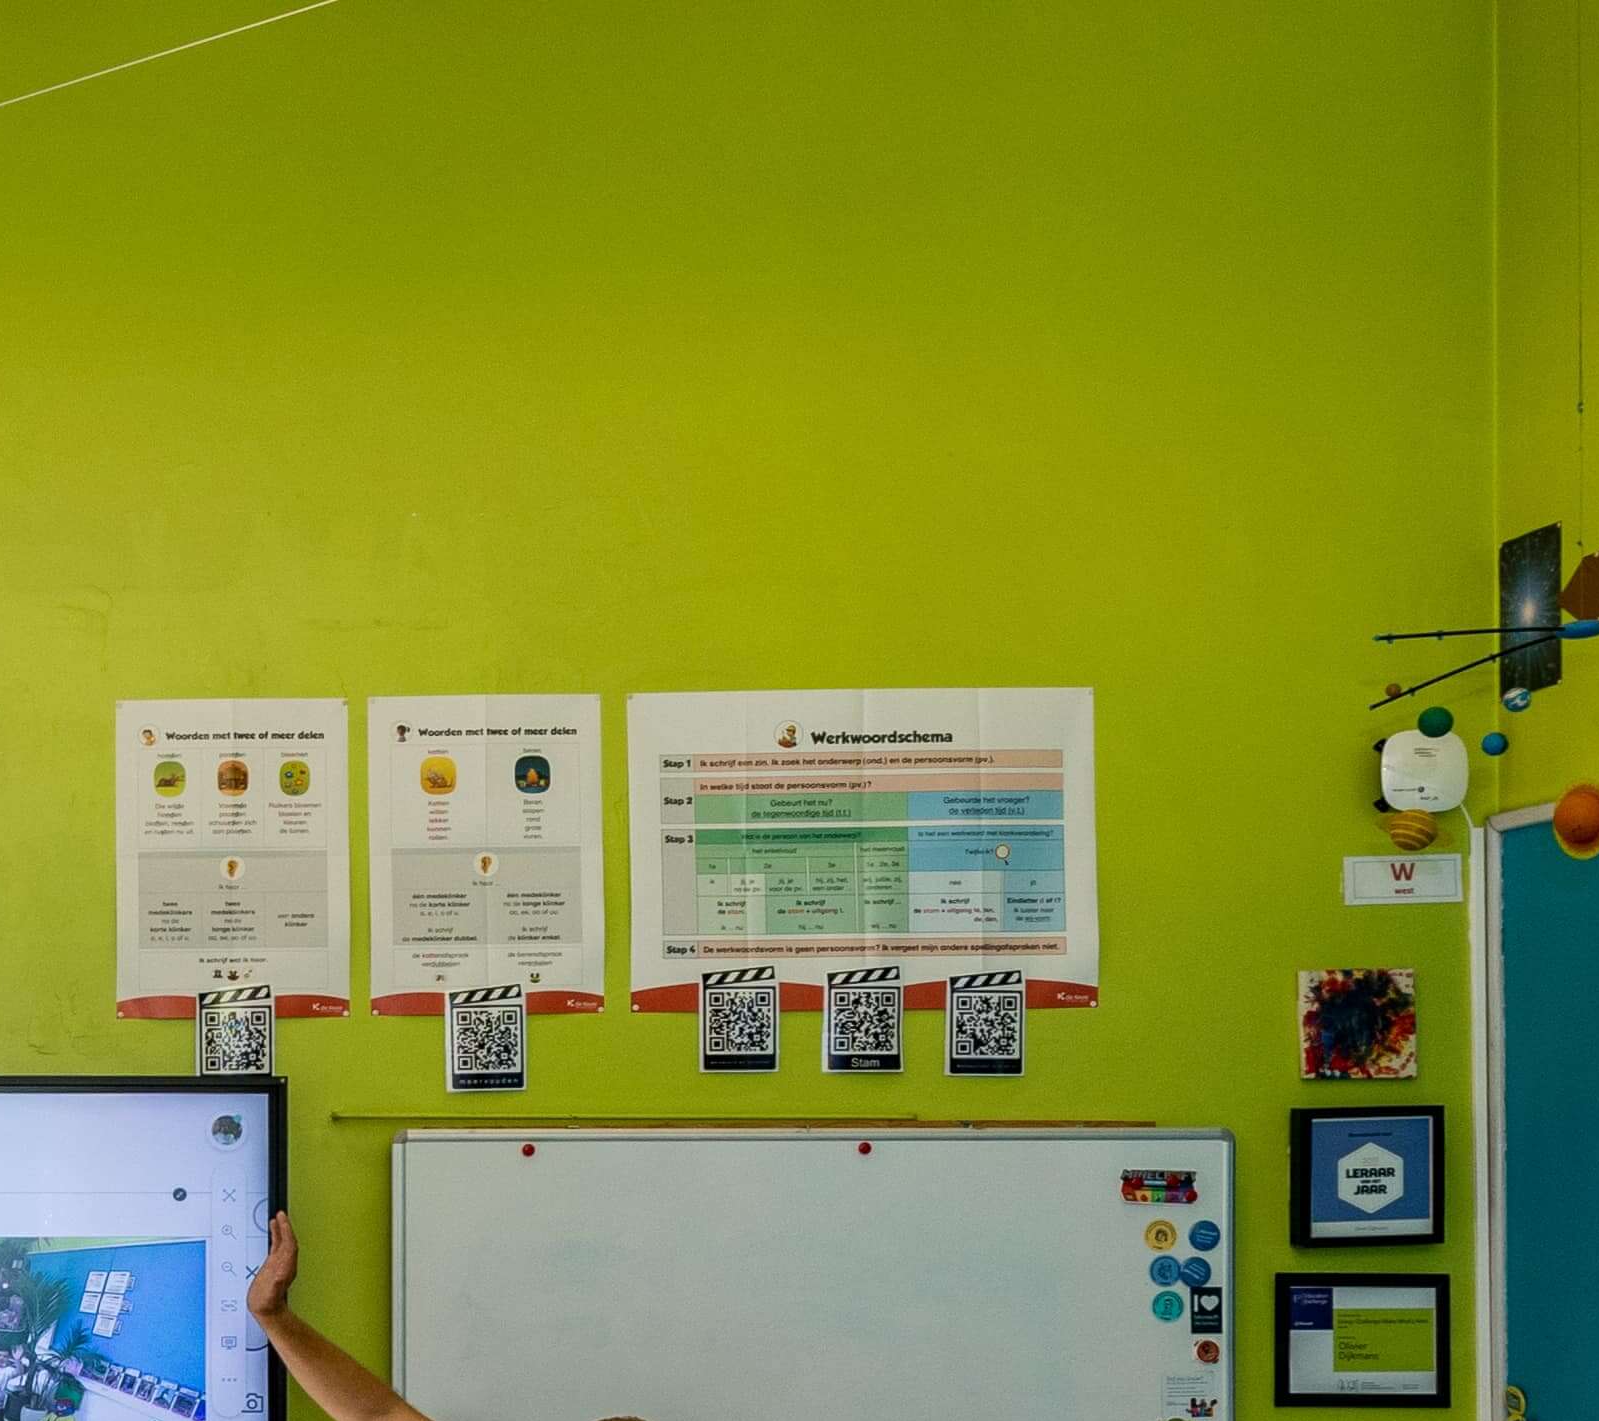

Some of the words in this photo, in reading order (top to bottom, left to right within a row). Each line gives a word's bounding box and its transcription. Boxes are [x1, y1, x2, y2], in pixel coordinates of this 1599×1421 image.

[165, 730, 209, 741] Woorden
[212, 730, 230, 741] met
[233, 730, 255, 741] twee
[258, 730, 268, 741] of
[271, 730, 295, 741] meer
[297, 730, 325, 741] delen
[418, 725, 462, 737] Woorden
[465, 725, 484, 737] met
[486, 725, 508, 737] twee
[511, 725, 521, 737] of
[524, 725, 548, 737] meer
[550, 725, 577, 737] delen
[811, 730, 953, 746] Werkwoordschema
[663, 760, 679, 768] Stap
[665, 836, 681, 844] Stap
[1391, 863, 1415, 881] W
[667, 945, 686, 956] Stap
[851, 1055, 881, 1068] Stam
[1346, 1168, 1395, 1178] LERAAR
[1354, 1184, 1387, 1195] JAAR
